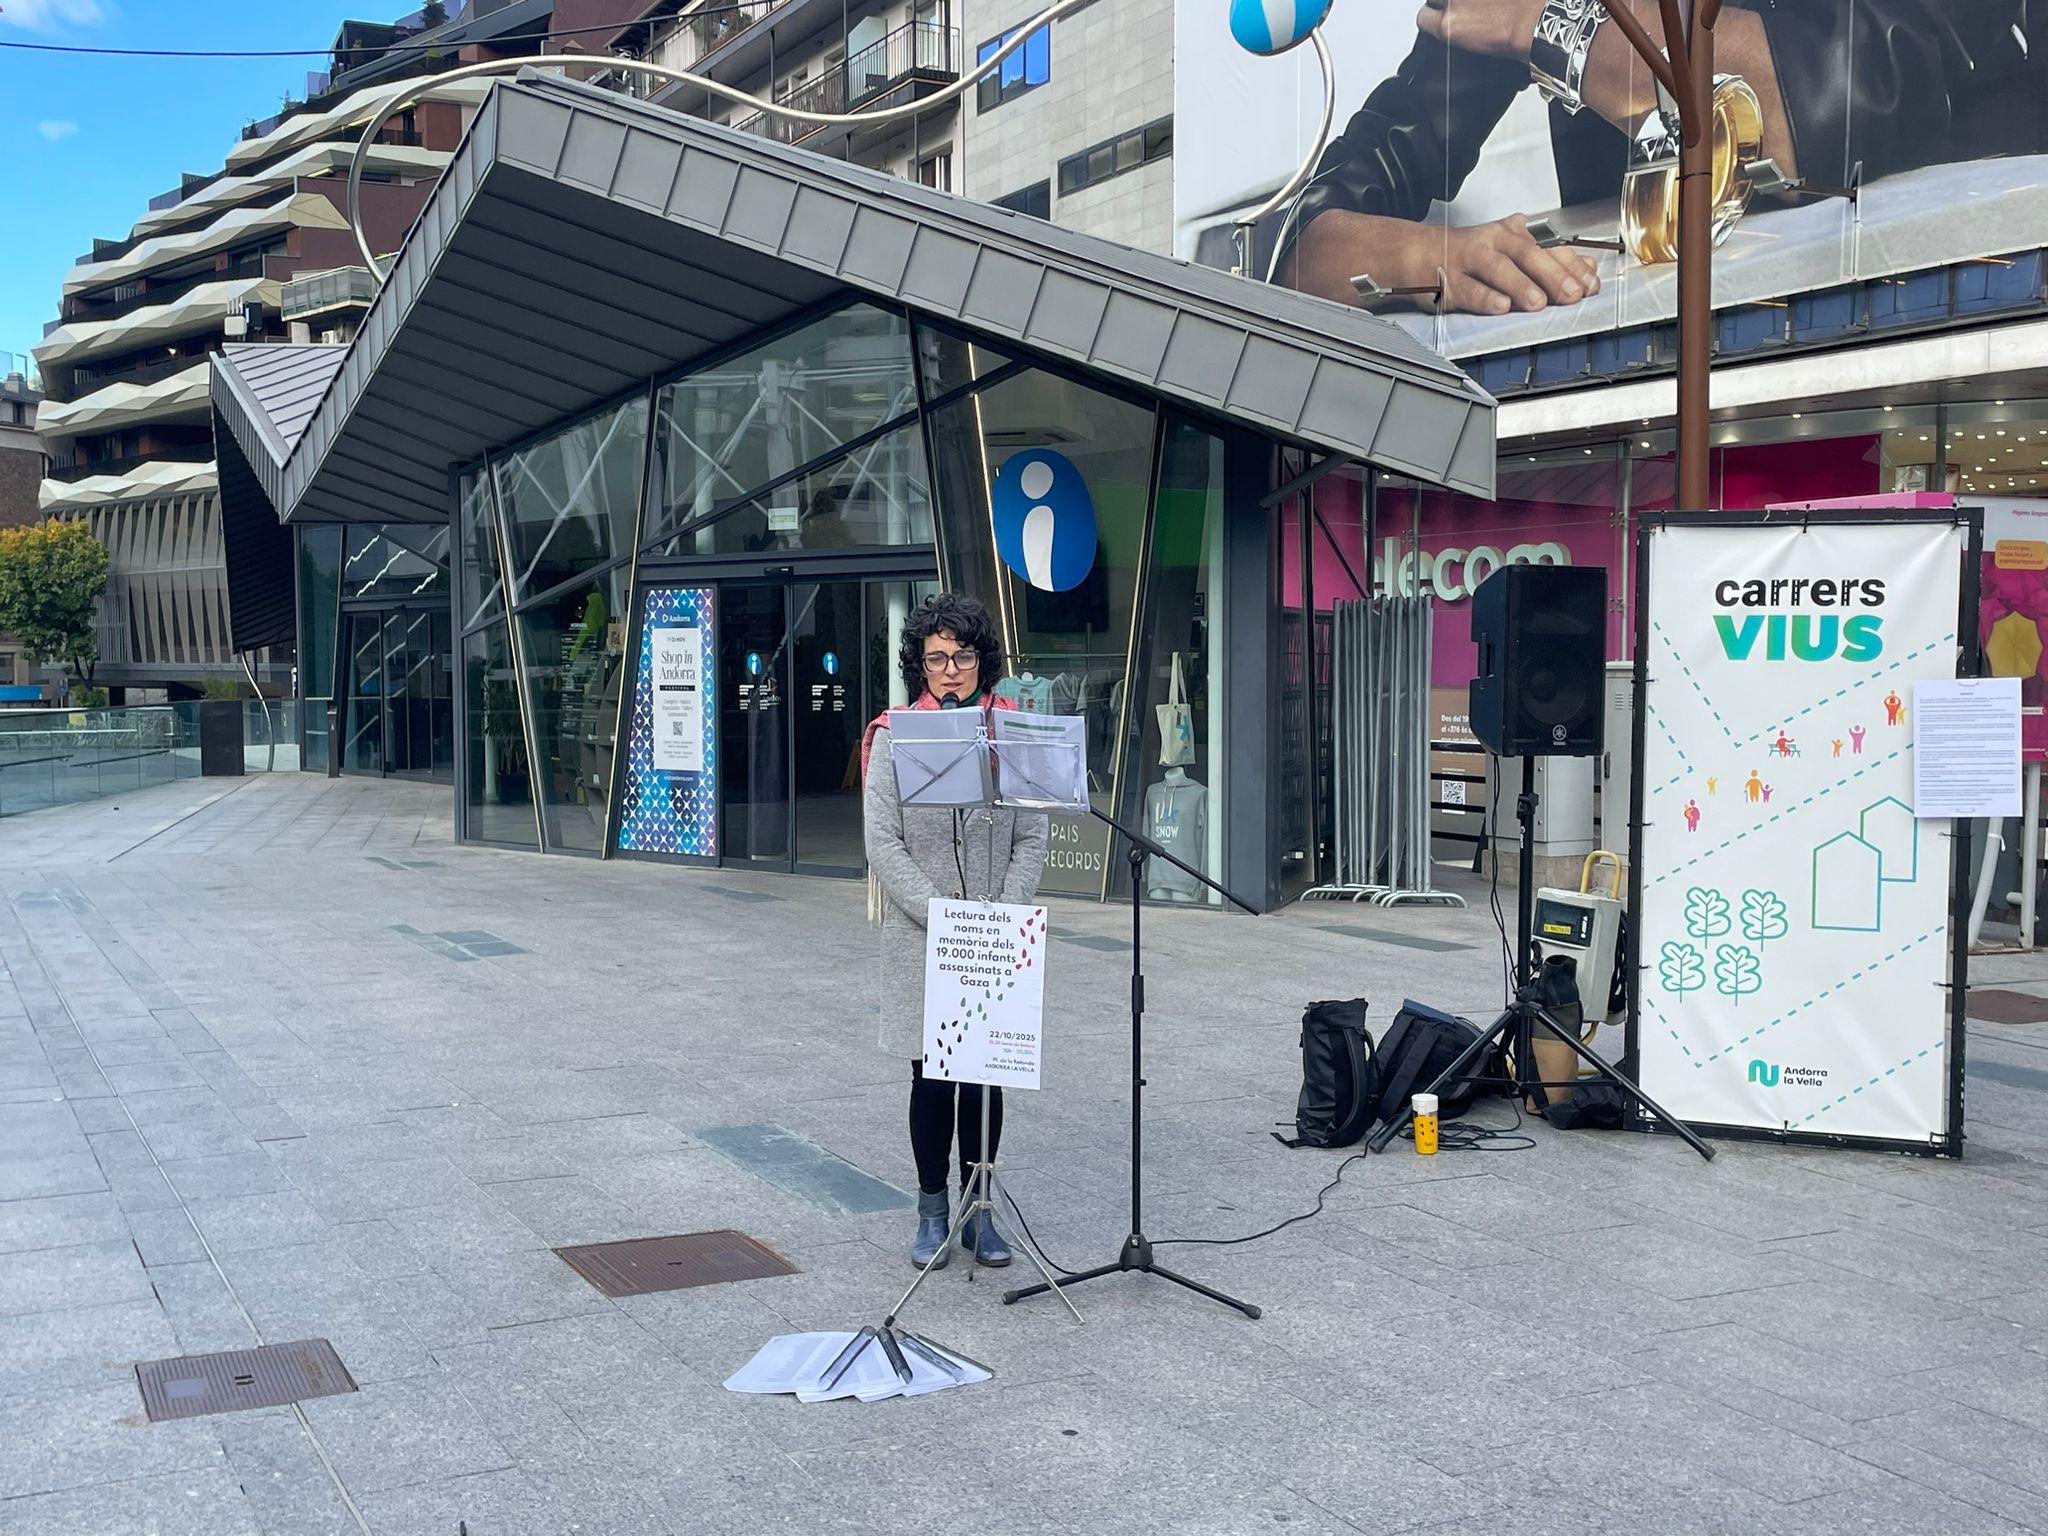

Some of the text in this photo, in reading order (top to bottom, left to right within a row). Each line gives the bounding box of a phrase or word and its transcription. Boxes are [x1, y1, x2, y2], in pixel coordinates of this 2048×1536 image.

[1715, 579, 1885, 607] carrers
[669, 614, 691, 622] Andorra
[1712, 614, 1884, 662] VIUS
[661, 650, 693, 667] Shop in
[660, 667, 696, 680] Andorra
[1441, 714, 1452, 722] Des
[1452, 714, 1462, 722] del
[1155, 825, 1179, 839] SNOW
[944, 907, 1011, 923] Lectura dels
[953, 925, 1000, 936] noms en
[939, 935, 1015, 950] memòria dels
[936, 947, 1016, 963] 19.000 infants
[939, 963, 1012, 976] assassinats a
[960, 975, 989, 988] Gaza
[990, 1030, 1035, 1041] 22/10/2025
[1784, 1066, 1828, 1077] Andorra
[1784, 1076, 1823, 1087] la Vella
